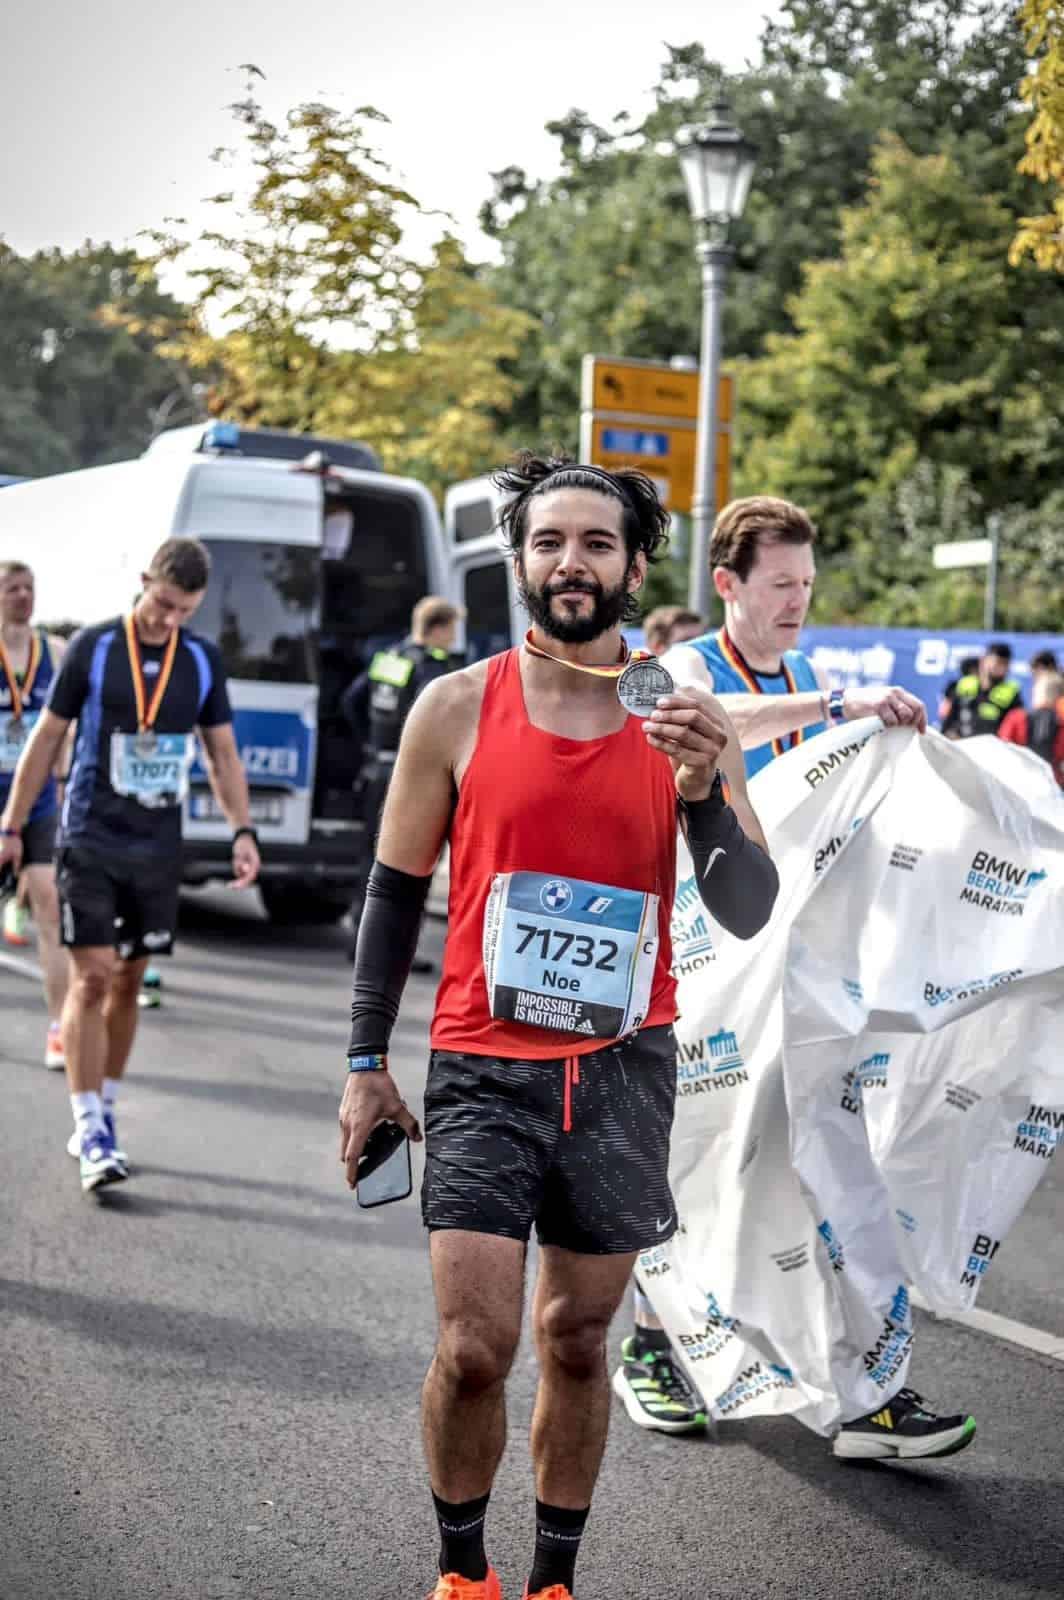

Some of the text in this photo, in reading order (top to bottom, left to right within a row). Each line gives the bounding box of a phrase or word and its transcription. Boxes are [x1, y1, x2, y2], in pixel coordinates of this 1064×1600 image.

[971, 850, 1026, 886] BMW
[515, 923, 619, 972] 71732
[643, 941, 653, 955] C
[671, 953, 717, 976] THON
[542, 970, 581, 992] Noe
[516, 991, 583, 1017] IMPOSSIBLE
[514, 1005, 577, 1031] IS NOTHING
[677, 1060, 710, 1078] RLIN
[720, 1381, 785, 1416] MARATH
